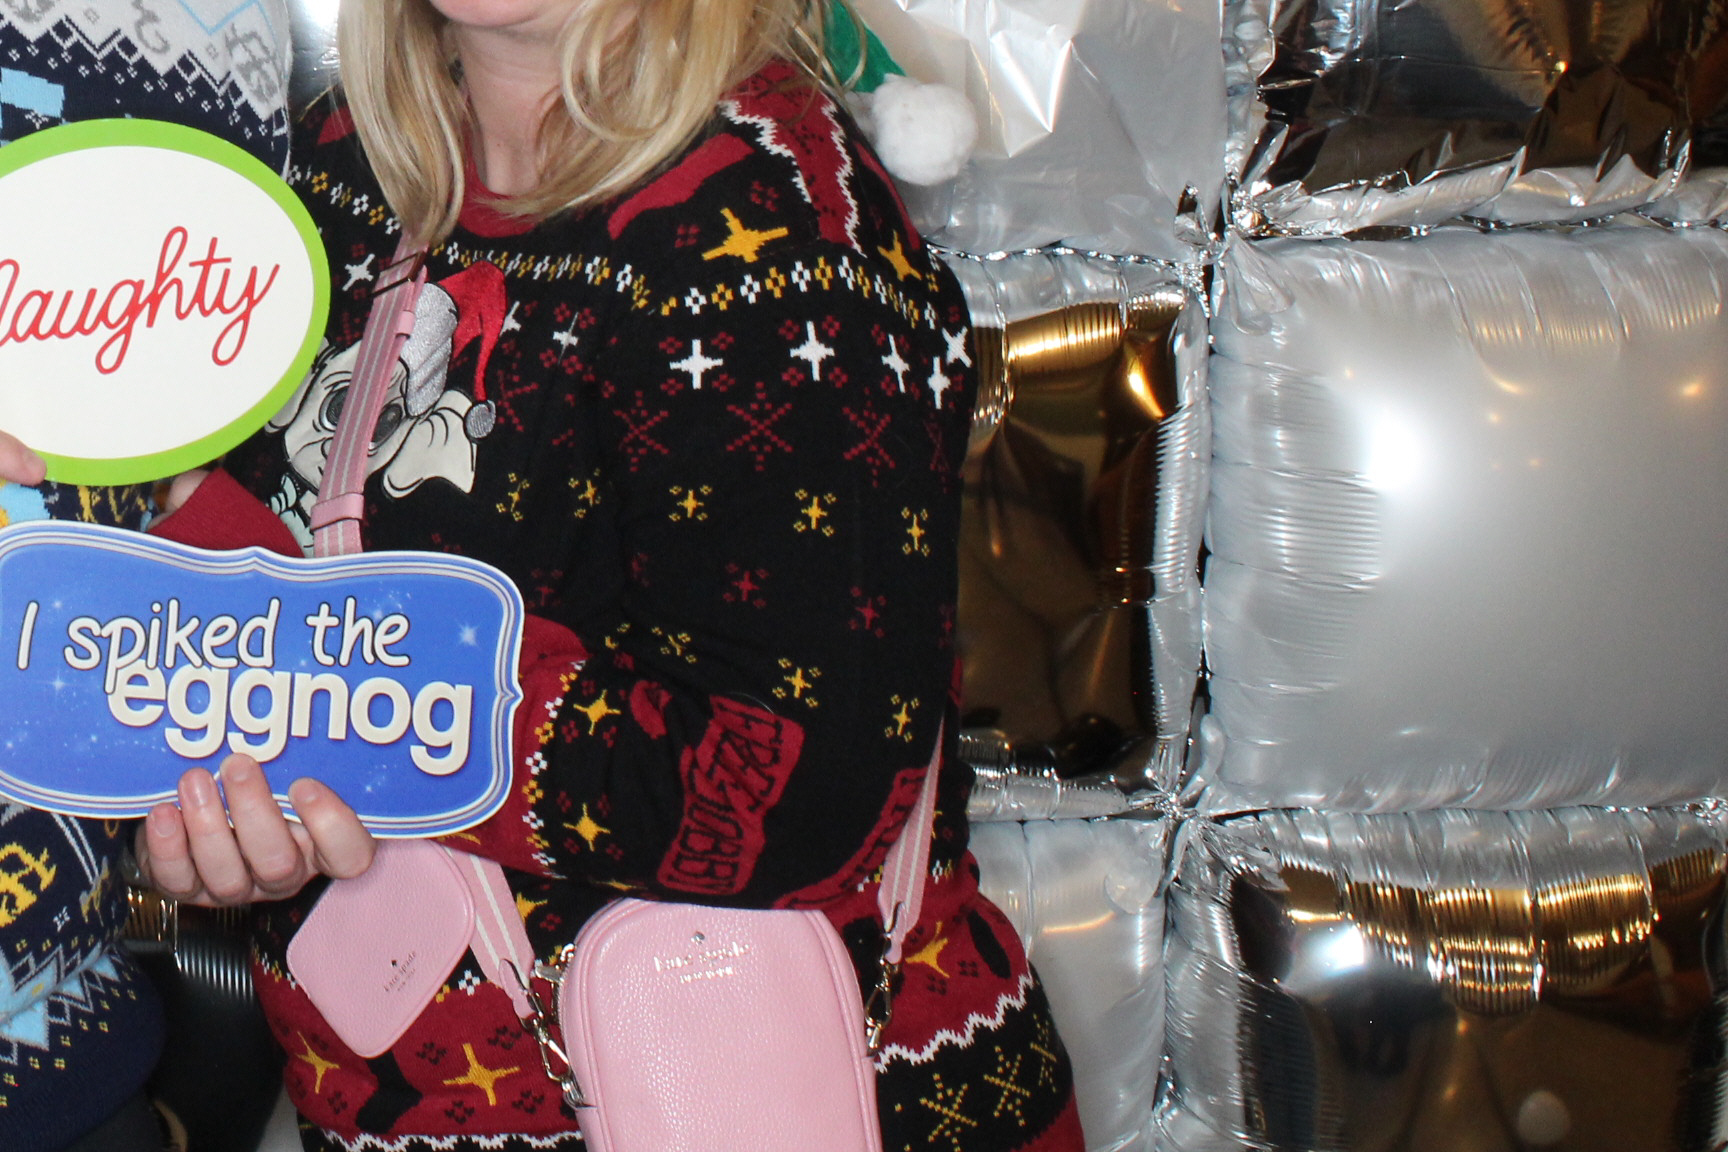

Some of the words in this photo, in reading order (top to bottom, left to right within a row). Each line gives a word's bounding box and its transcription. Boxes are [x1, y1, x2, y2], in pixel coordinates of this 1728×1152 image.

[17, 600, 39, 671] I
[62, 596, 281, 694] spiked
[305, 596, 411, 668] the
[107, 660, 473, 776] eggnog
